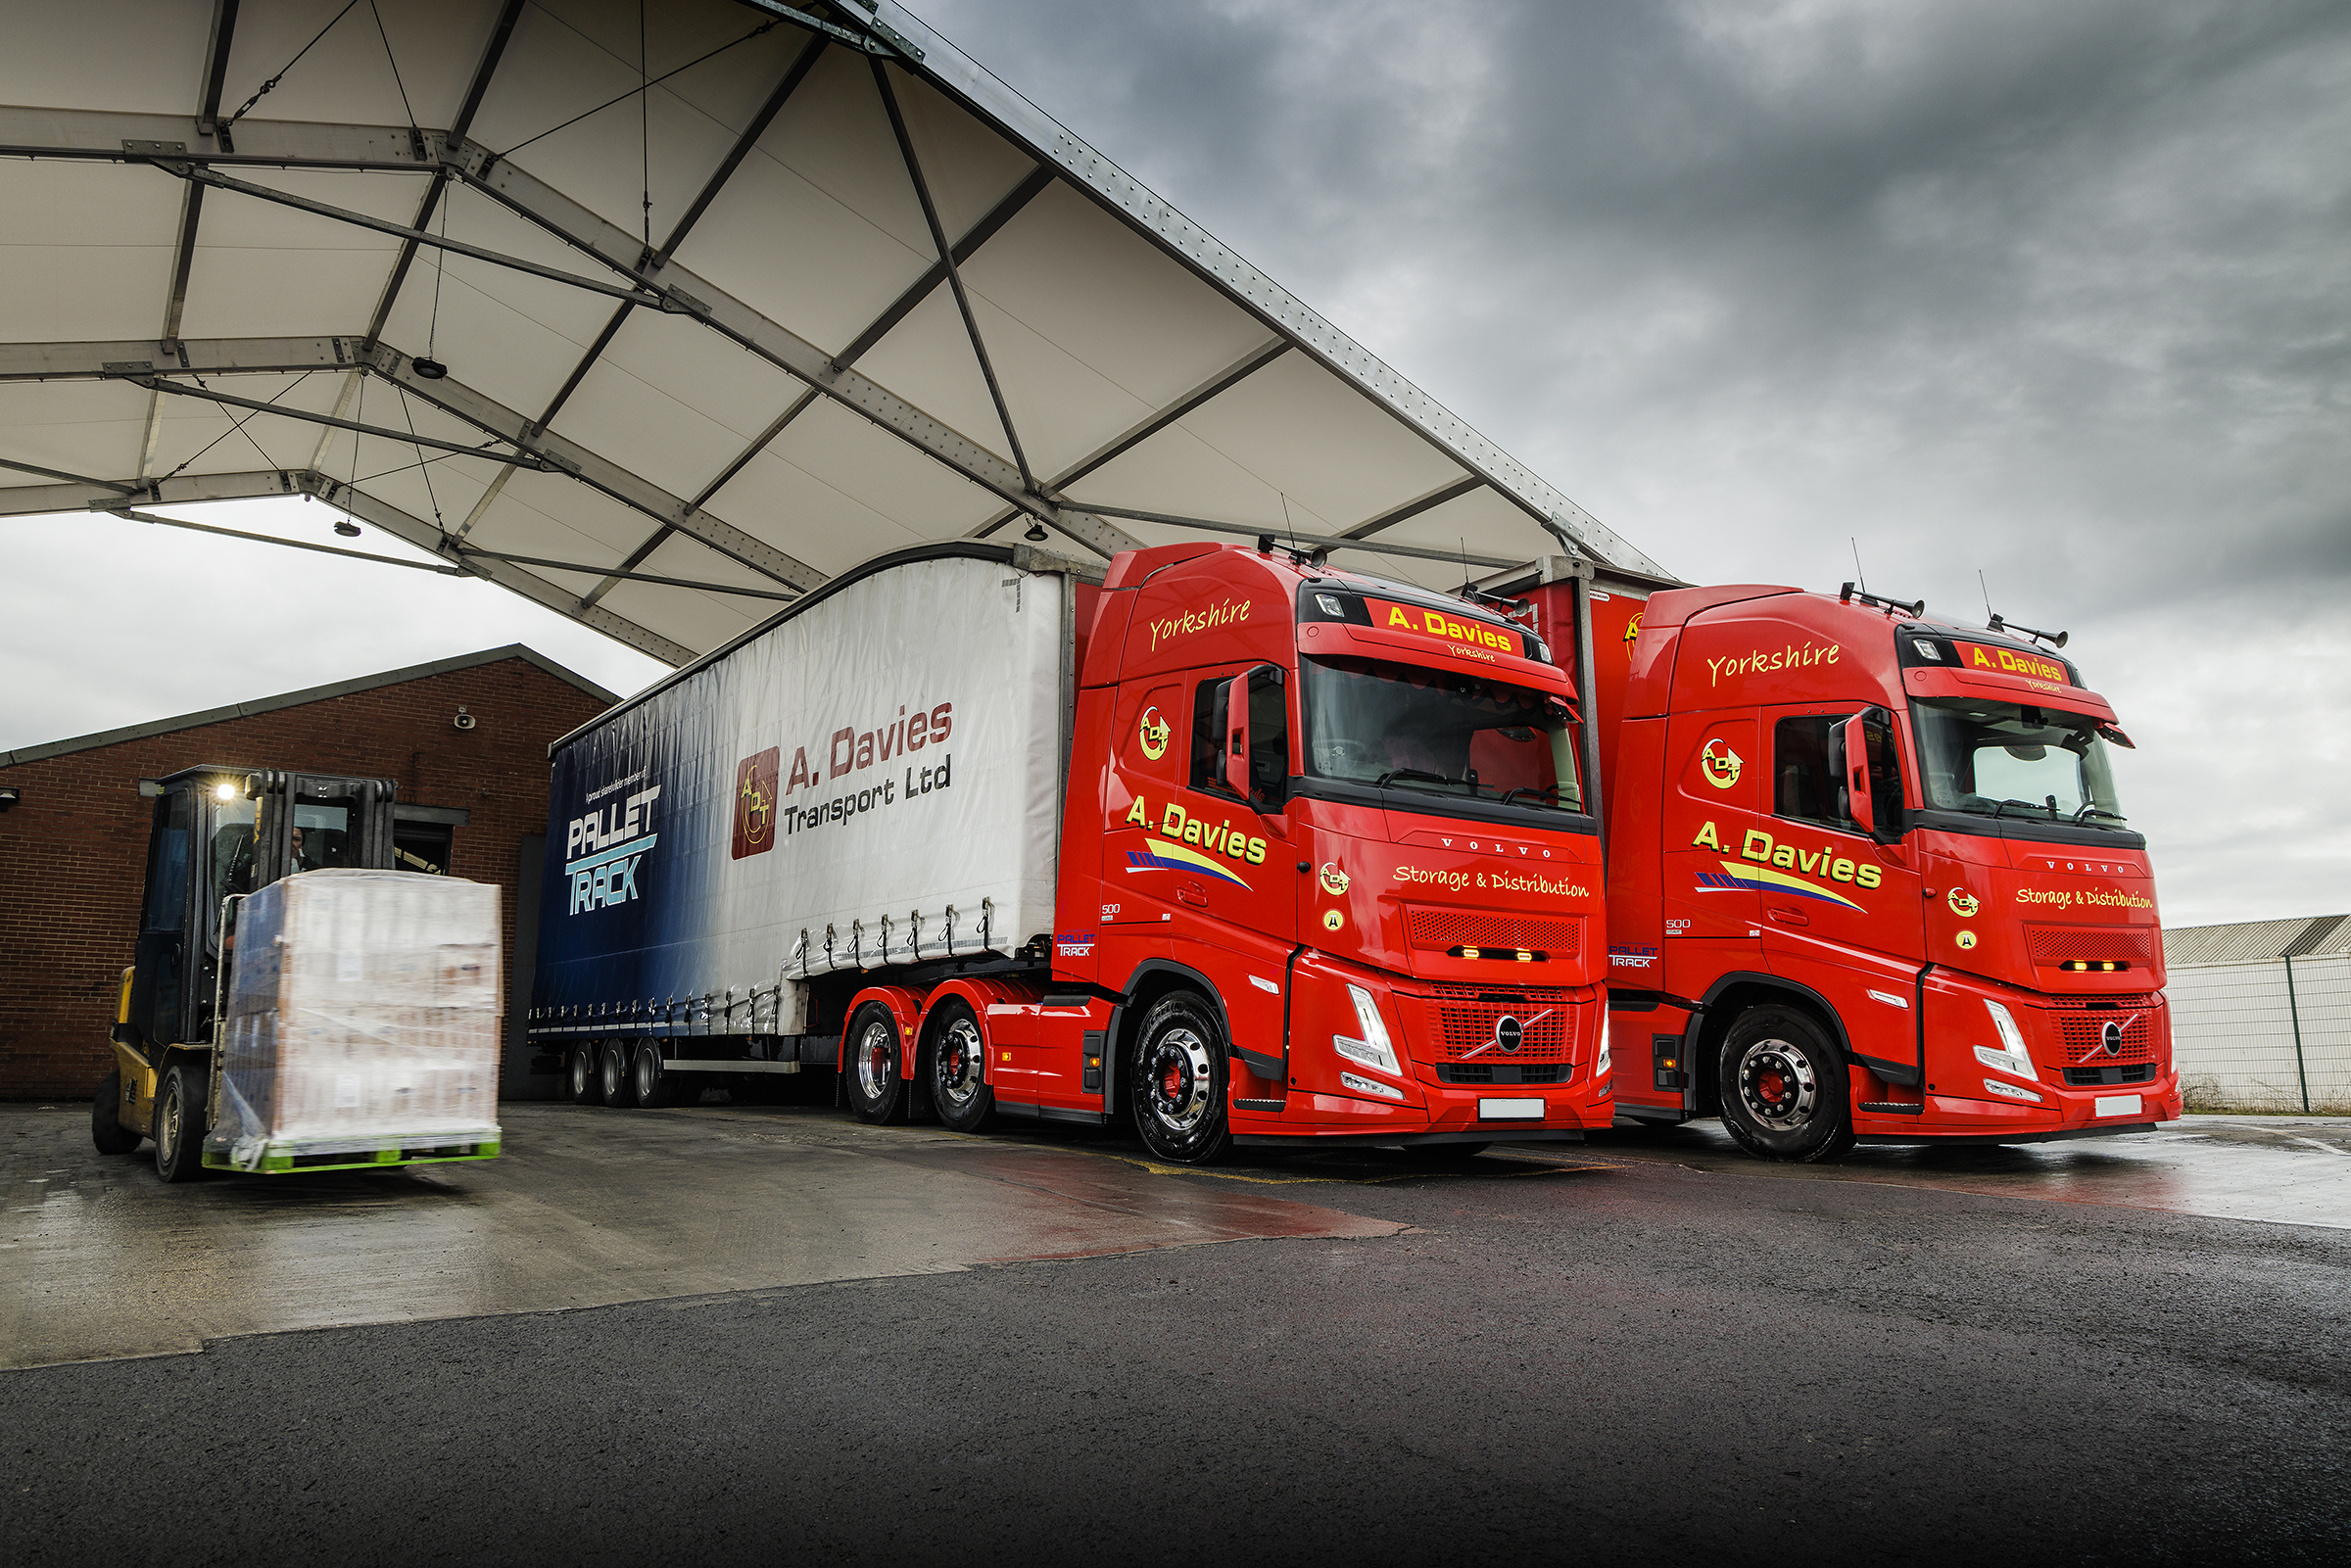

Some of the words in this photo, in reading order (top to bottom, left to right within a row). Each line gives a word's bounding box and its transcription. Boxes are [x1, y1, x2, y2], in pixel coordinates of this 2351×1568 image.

[1150, 597, 1251, 652] Yorkshire
[1388, 606, 1419, 631] A.
[1423, 611, 1512, 652] Davies
[1447, 643, 1496, 663] Yorkshire
[1707, 641, 1840, 688] Yorkshire
[1974, 647, 1997, 668] A.
[1997, 649, 2062, 682] Davies
[785, 745, 820, 796] A.
[830, 701, 953, 781] Davies
[785, 779, 895, 834] Transport
[905, 753, 951, 800] Ltd
[566, 784, 662, 860] PALLET
[1125, 794, 1154, 832] A.
[1160, 802, 1267, 867] Davies
[1441, 837, 1551, 858] VOLVO
[1692, 821, 1731, 855] A.
[1741, 829, 1883, 891] Davies
[565, 833, 658, 916] TRACK
[1392, 866, 1469, 892] Storage
[1475, 872, 1487, 888] &
[1492, 871, 1590, 898] Distribution
[2046, 860, 2124, 874] VOLVO
[1101, 903, 1121, 915] 500
[2016, 888, 2072, 910] Storage
[2076, 891, 2084, 905] &
[2087, 887, 2153, 909] Distribution
[1057, 933, 1096, 944] PALLET
[1666, 919, 1691, 928] 500
[1057, 943, 1095, 957] TRACK
[1608, 945, 1658, 956] PALLET
[1608, 954, 1657, 968] TRACK
